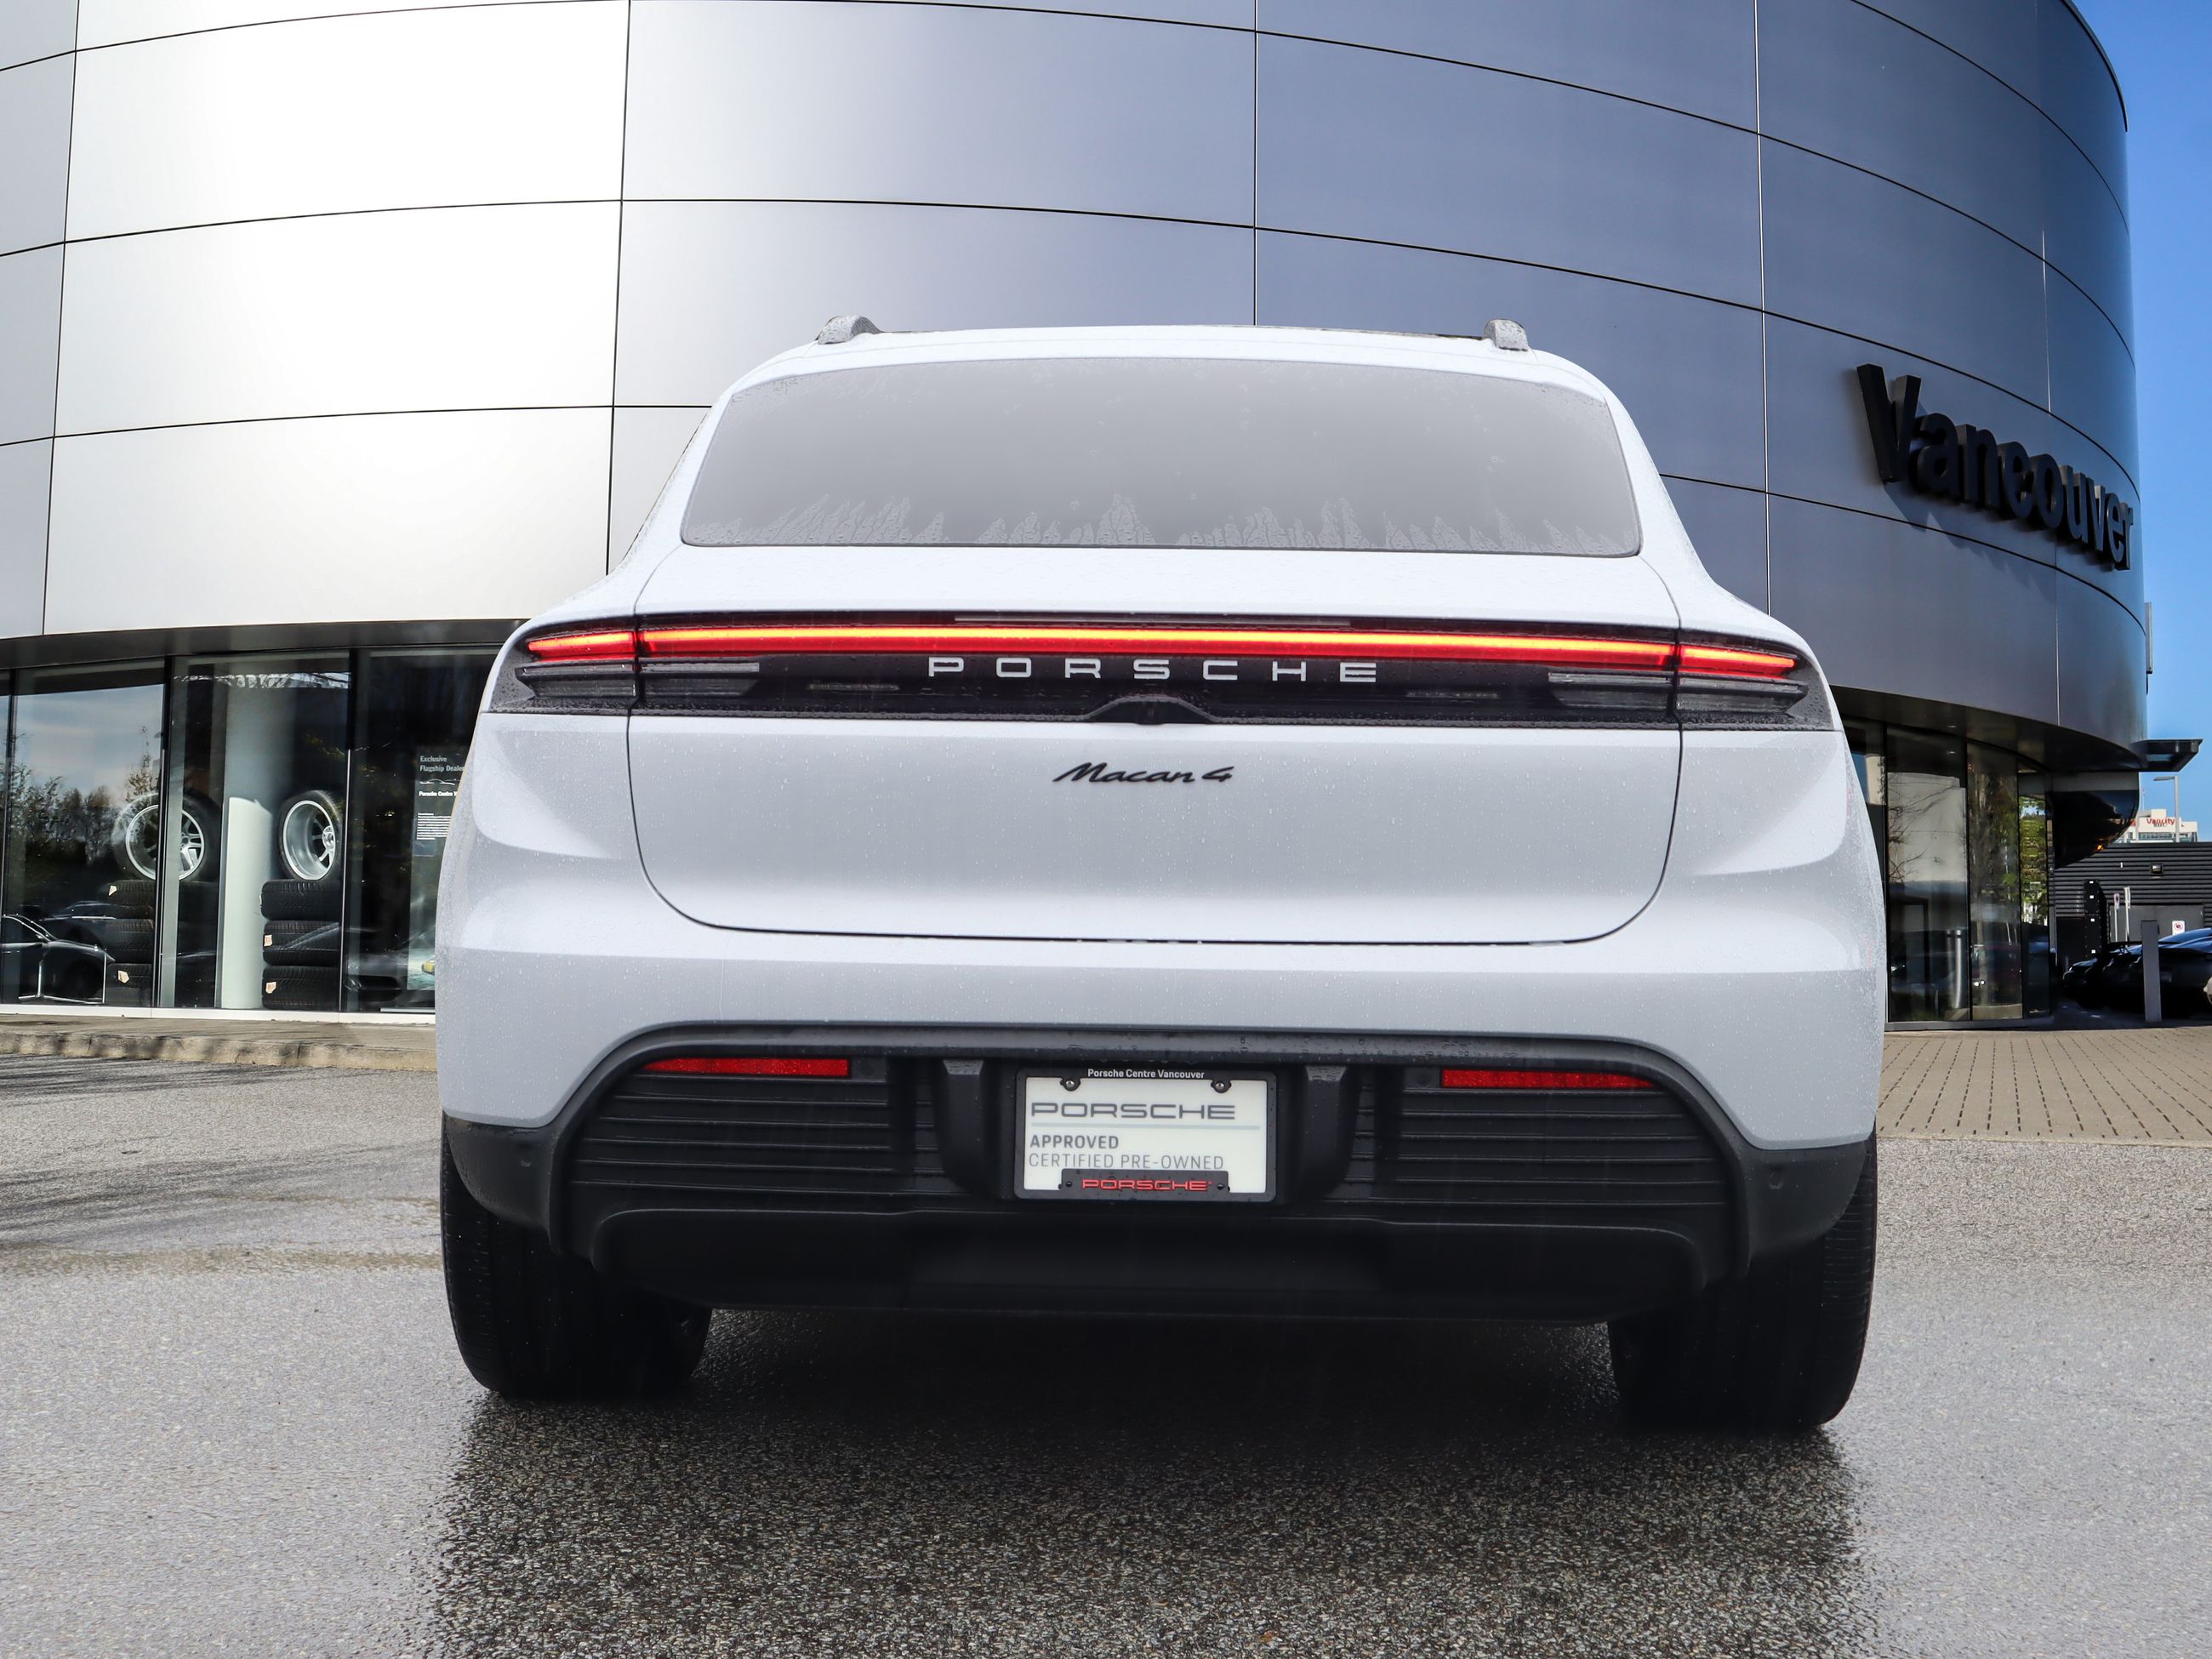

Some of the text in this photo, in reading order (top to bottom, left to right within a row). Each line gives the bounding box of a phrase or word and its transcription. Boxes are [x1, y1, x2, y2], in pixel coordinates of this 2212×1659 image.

[1856, 363, 2134, 571] Vancouver
[928, 657, 1377, 682] PORSCHE
[1052, 762, 1234, 783] Macan 4
[1087, 1069, 1205, 1079] Porsche Centre Vancouver
[1031, 1102, 1235, 1120] PORSCHE
[1029, 1134, 1119, 1149] APPROVED
[1029, 1153, 1224, 1170] CERTIFIED PRE-OWNED
[1081, 1178, 1208, 1191] PORSCHE
